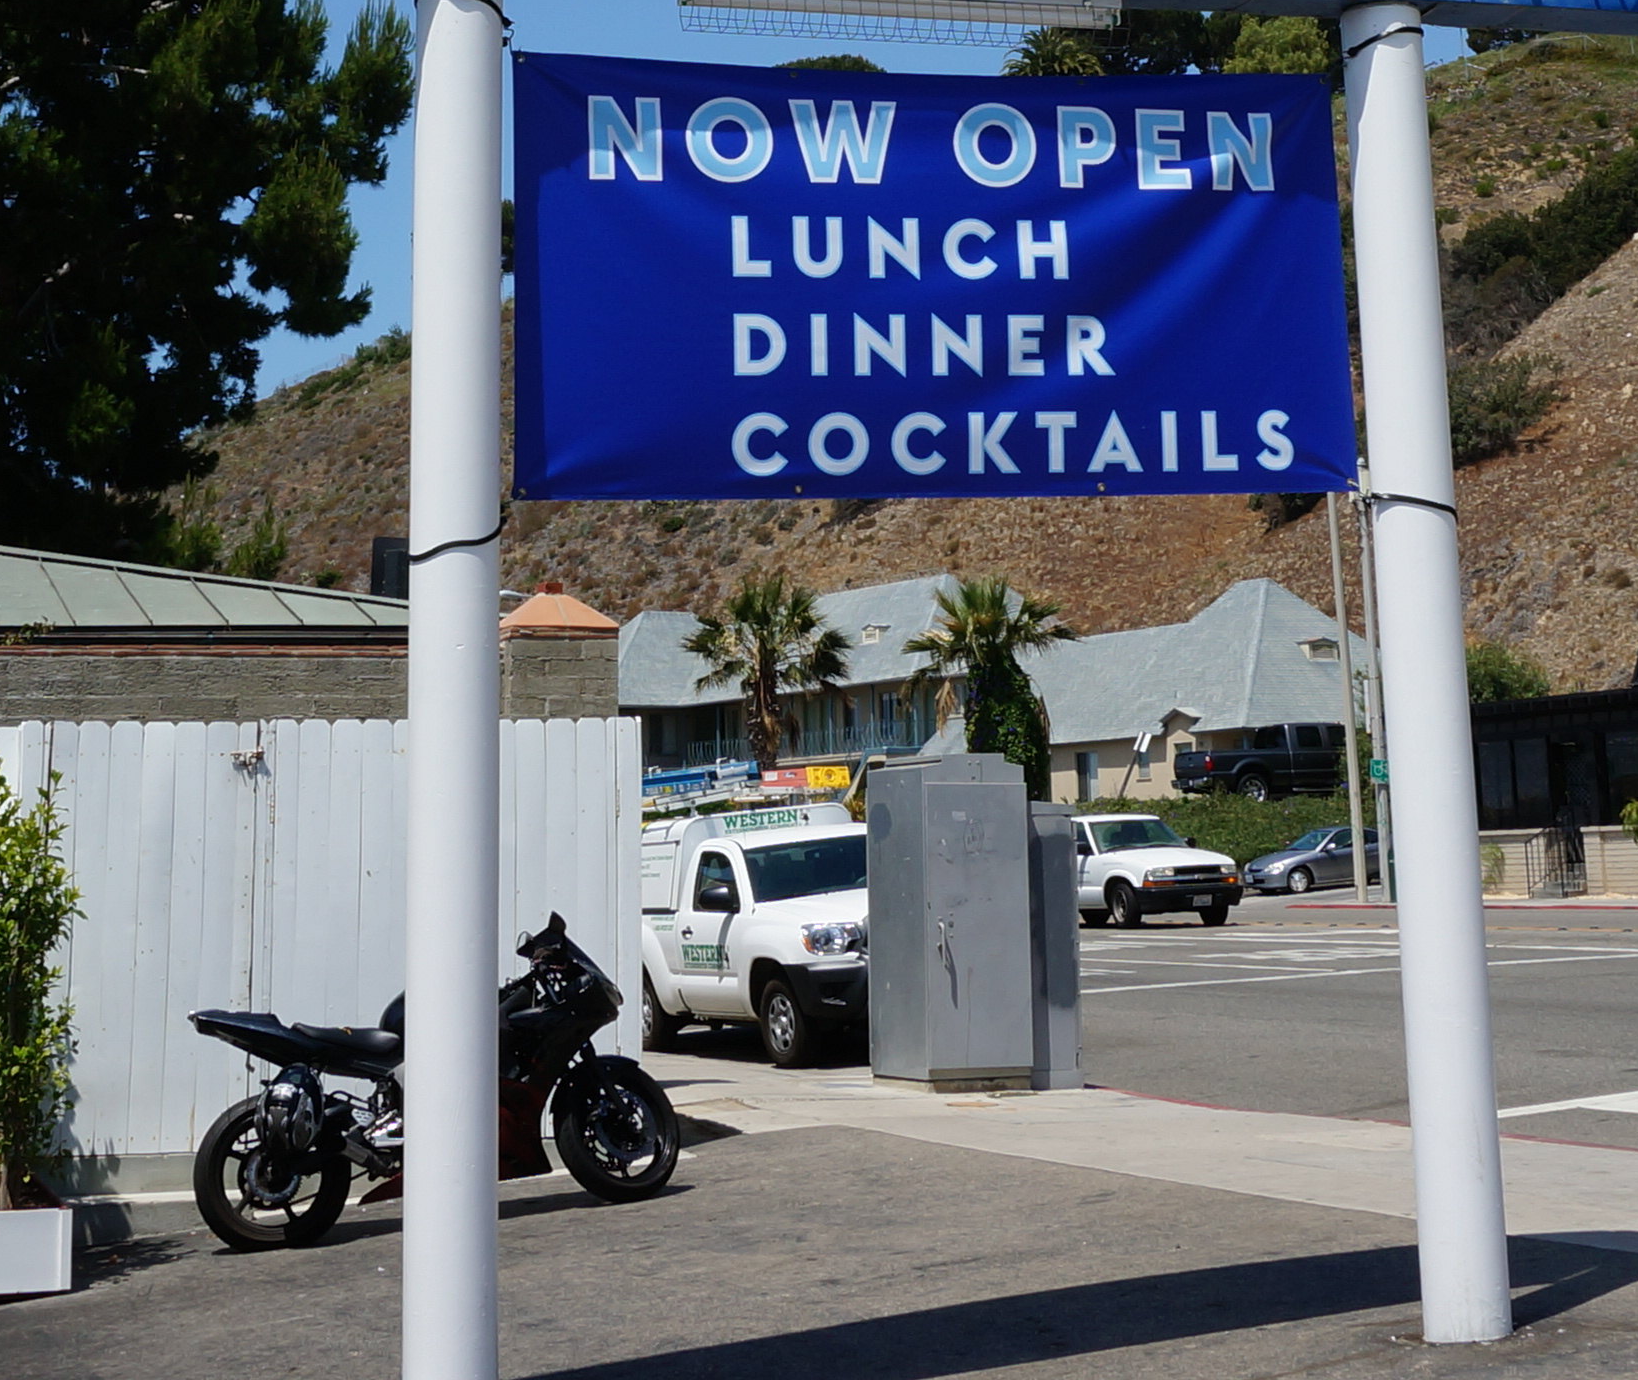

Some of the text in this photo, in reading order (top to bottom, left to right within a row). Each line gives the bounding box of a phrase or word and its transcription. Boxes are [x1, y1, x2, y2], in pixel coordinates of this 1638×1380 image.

[587, 95, 1275, 192] NOW OPEN
[731, 214, 1070, 282] LUNCH
[733, 313, 1116, 377] DINNER
[731, 409, 1295, 477] COCKTAILS
[723, 809, 798, 829] WESTERN
[682, 944, 724, 962] WESTERN
